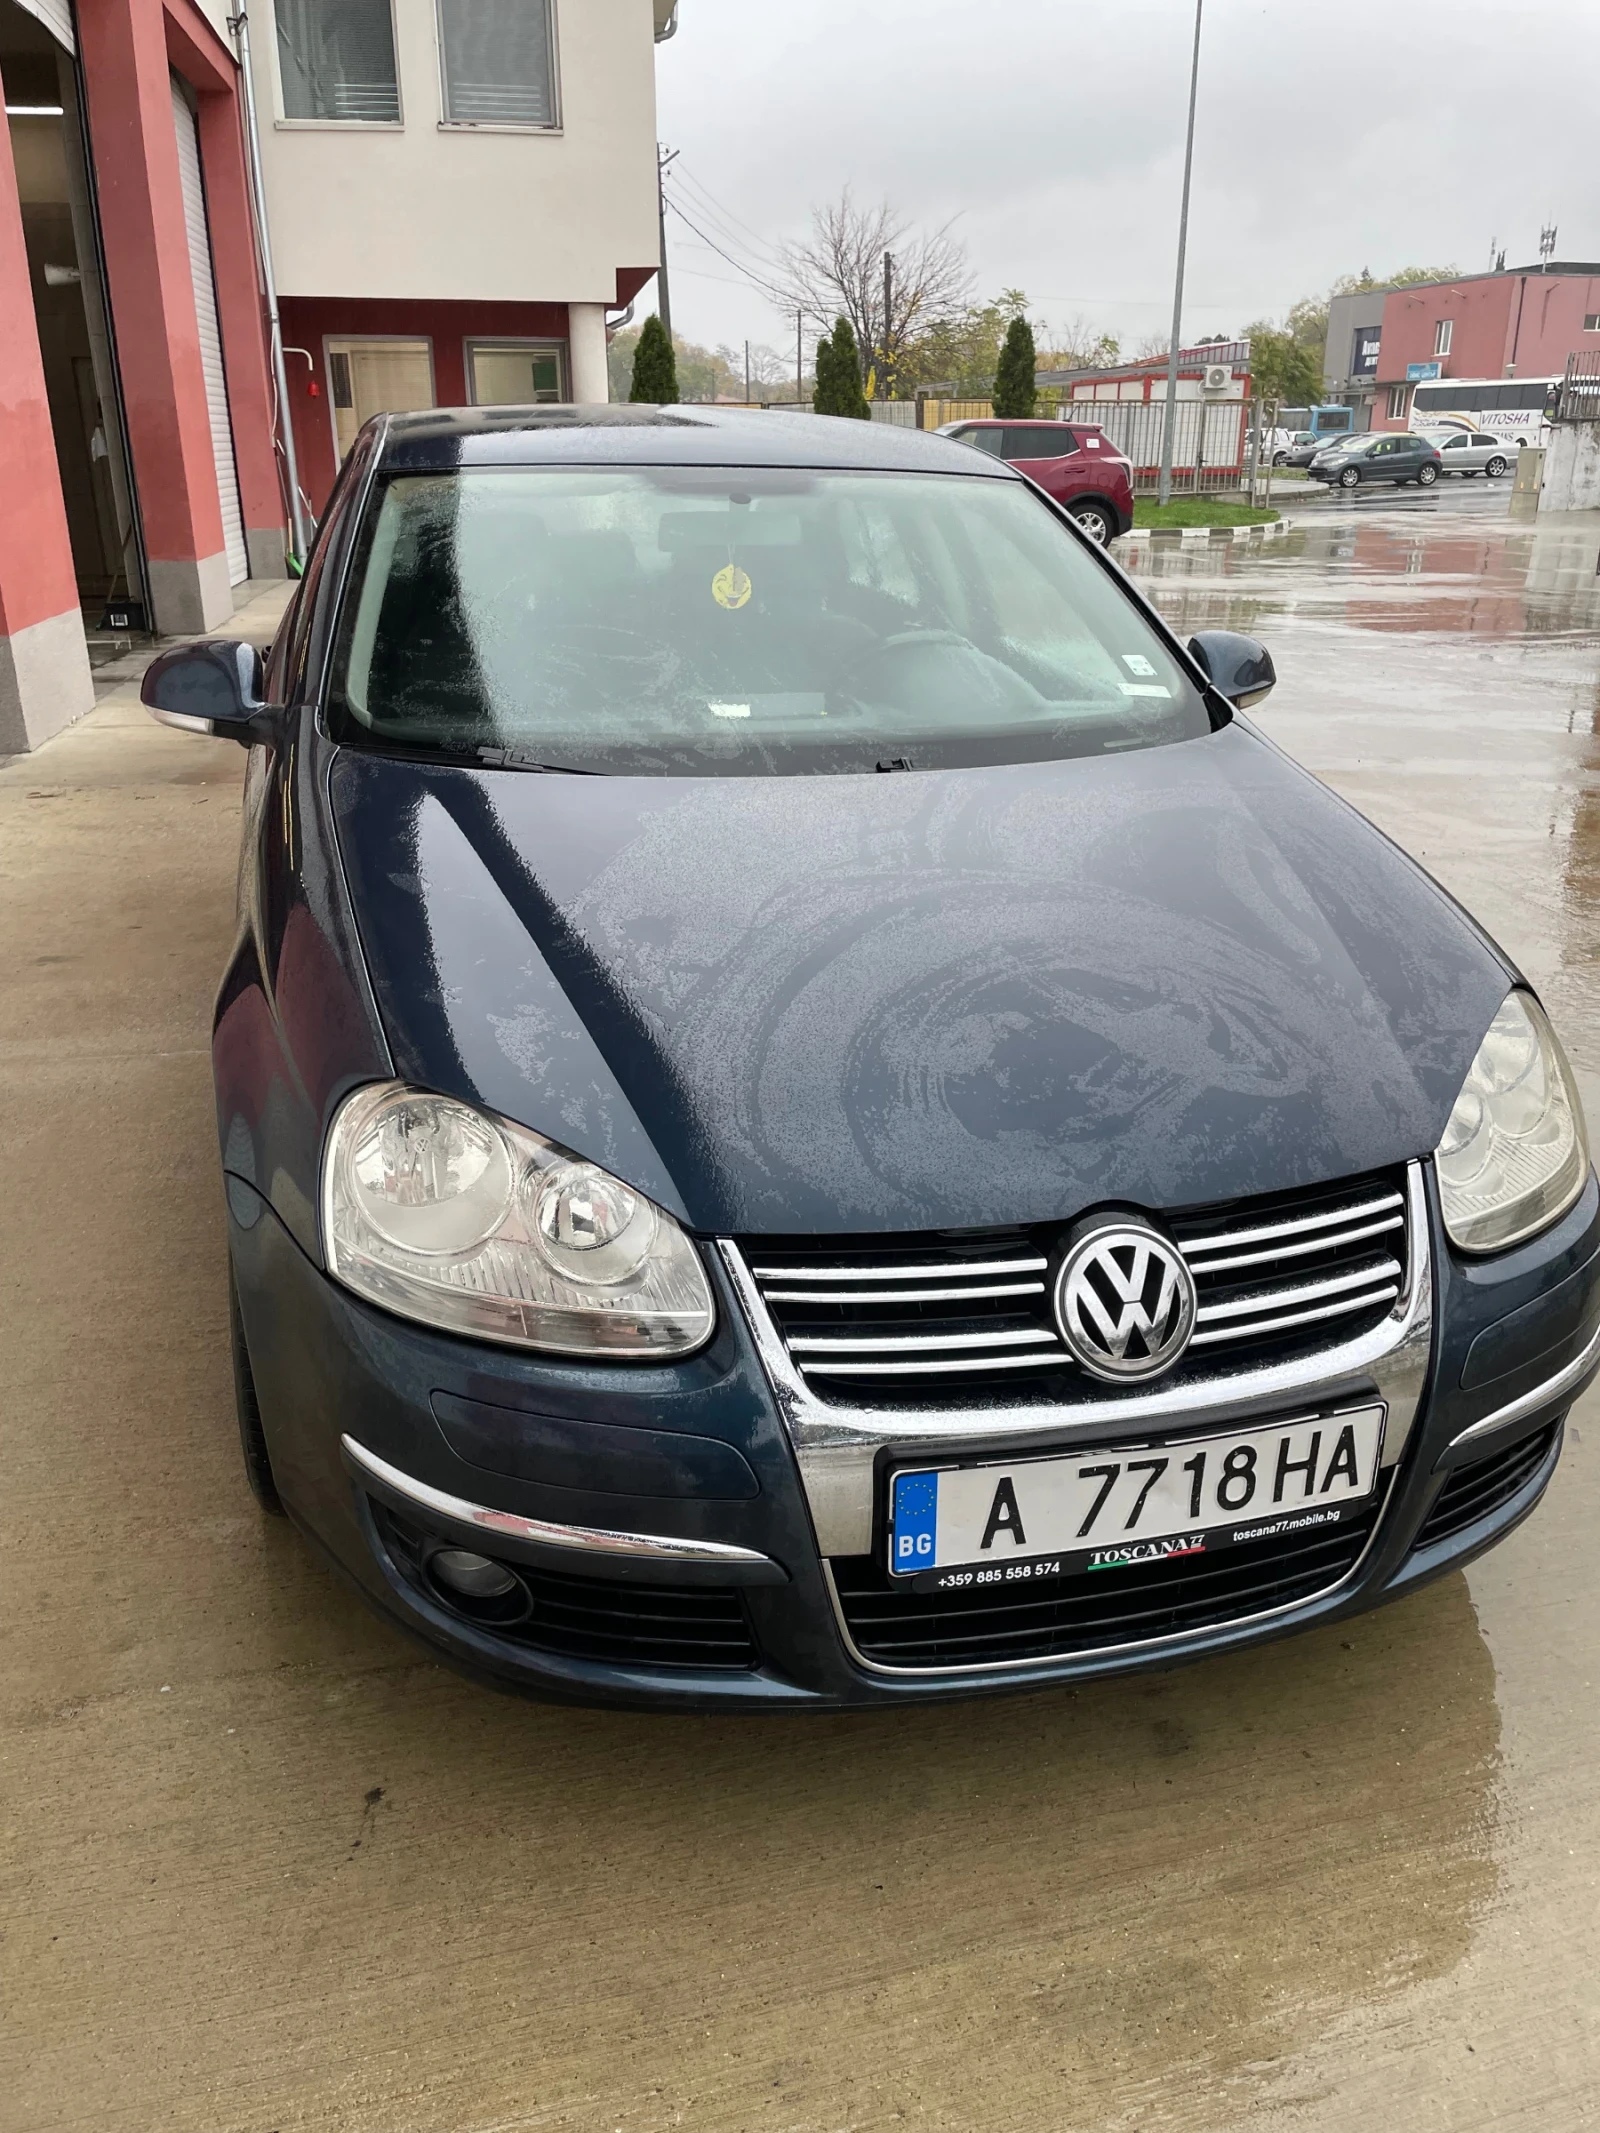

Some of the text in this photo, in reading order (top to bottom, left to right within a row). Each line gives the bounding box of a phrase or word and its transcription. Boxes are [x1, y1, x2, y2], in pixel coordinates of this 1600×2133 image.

[1481, 412, 1530, 425] VITOSHA
[979, 1424, 1359, 1550] A 7718 HA
[1233, 1509, 1341, 1542] toscana77.mobile.bg
[898, 1533, 932, 1558] BG
[938, 1561, 1060, 1587] +359 885 558 574
